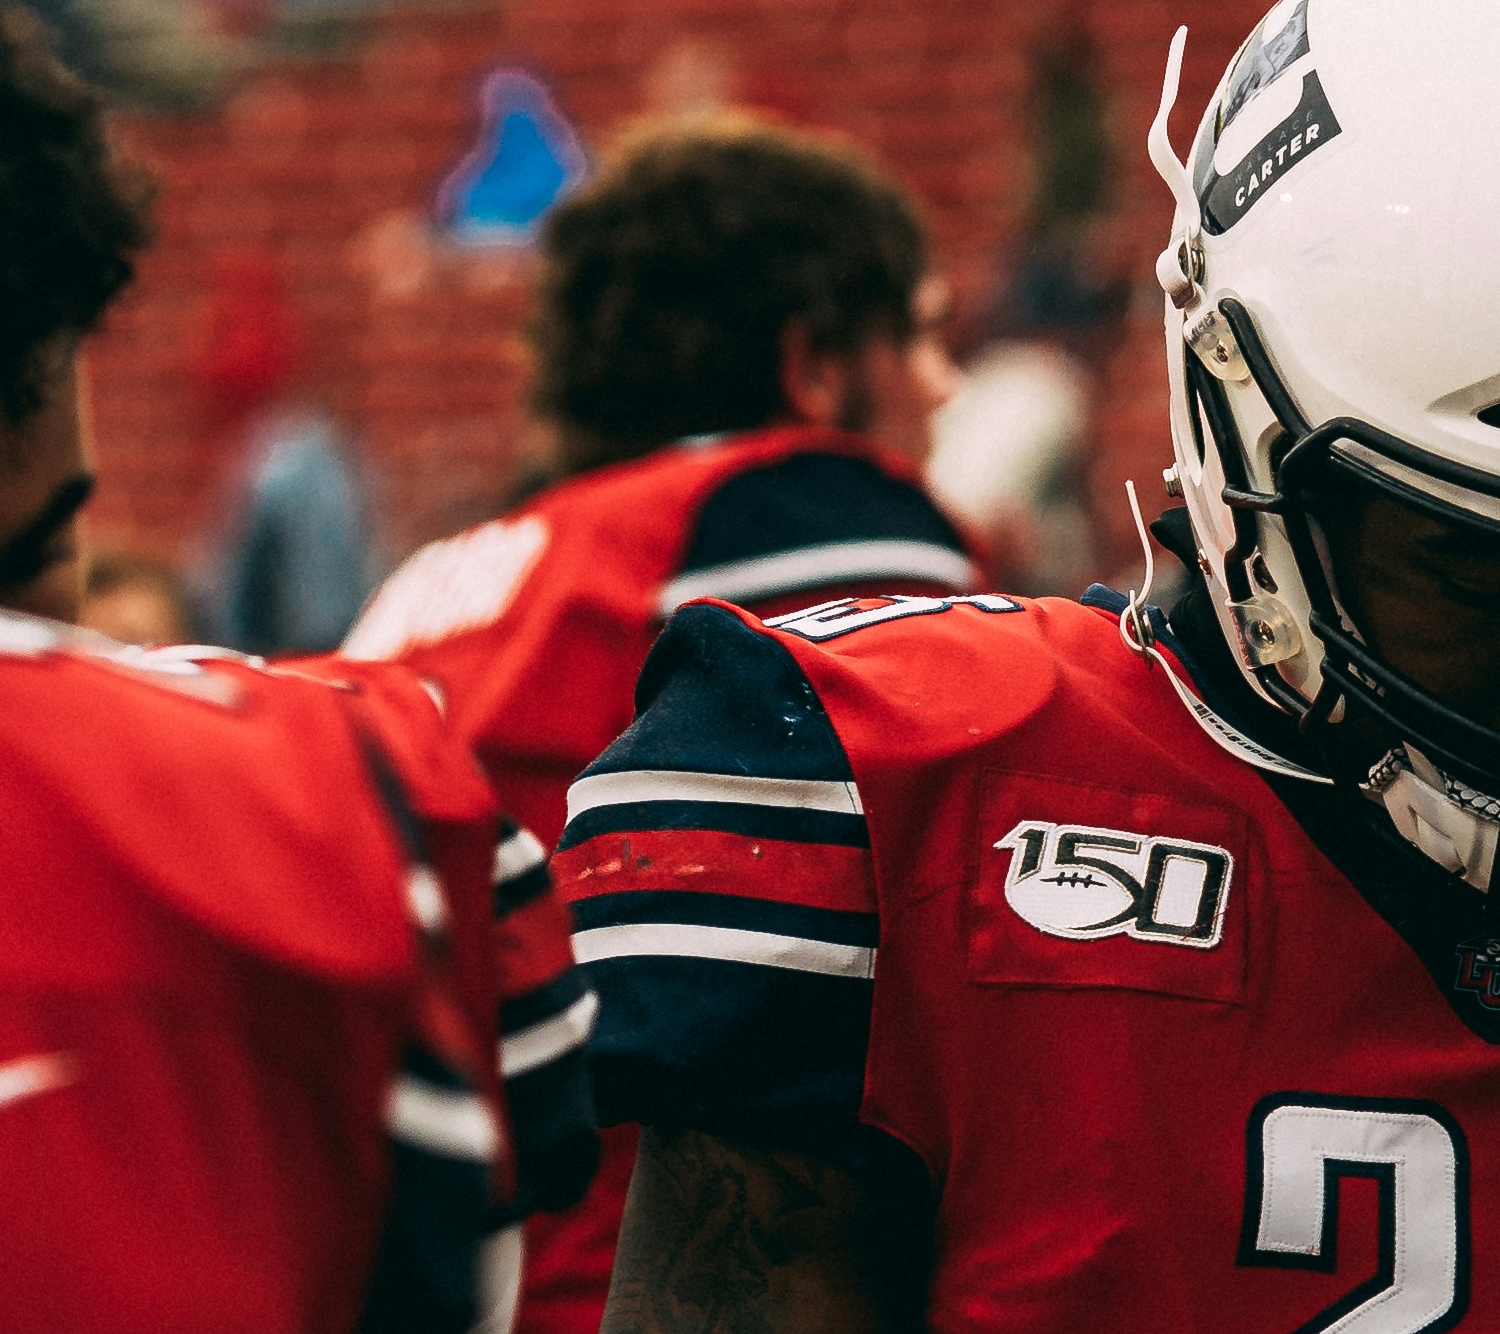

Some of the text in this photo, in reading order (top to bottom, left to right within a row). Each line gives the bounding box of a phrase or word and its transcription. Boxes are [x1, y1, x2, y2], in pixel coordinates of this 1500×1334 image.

[1234, 109, 1315, 185] WALLACE
[1234, 122, 1320, 208] CARTER
[1010, 825, 1234, 943] 150
